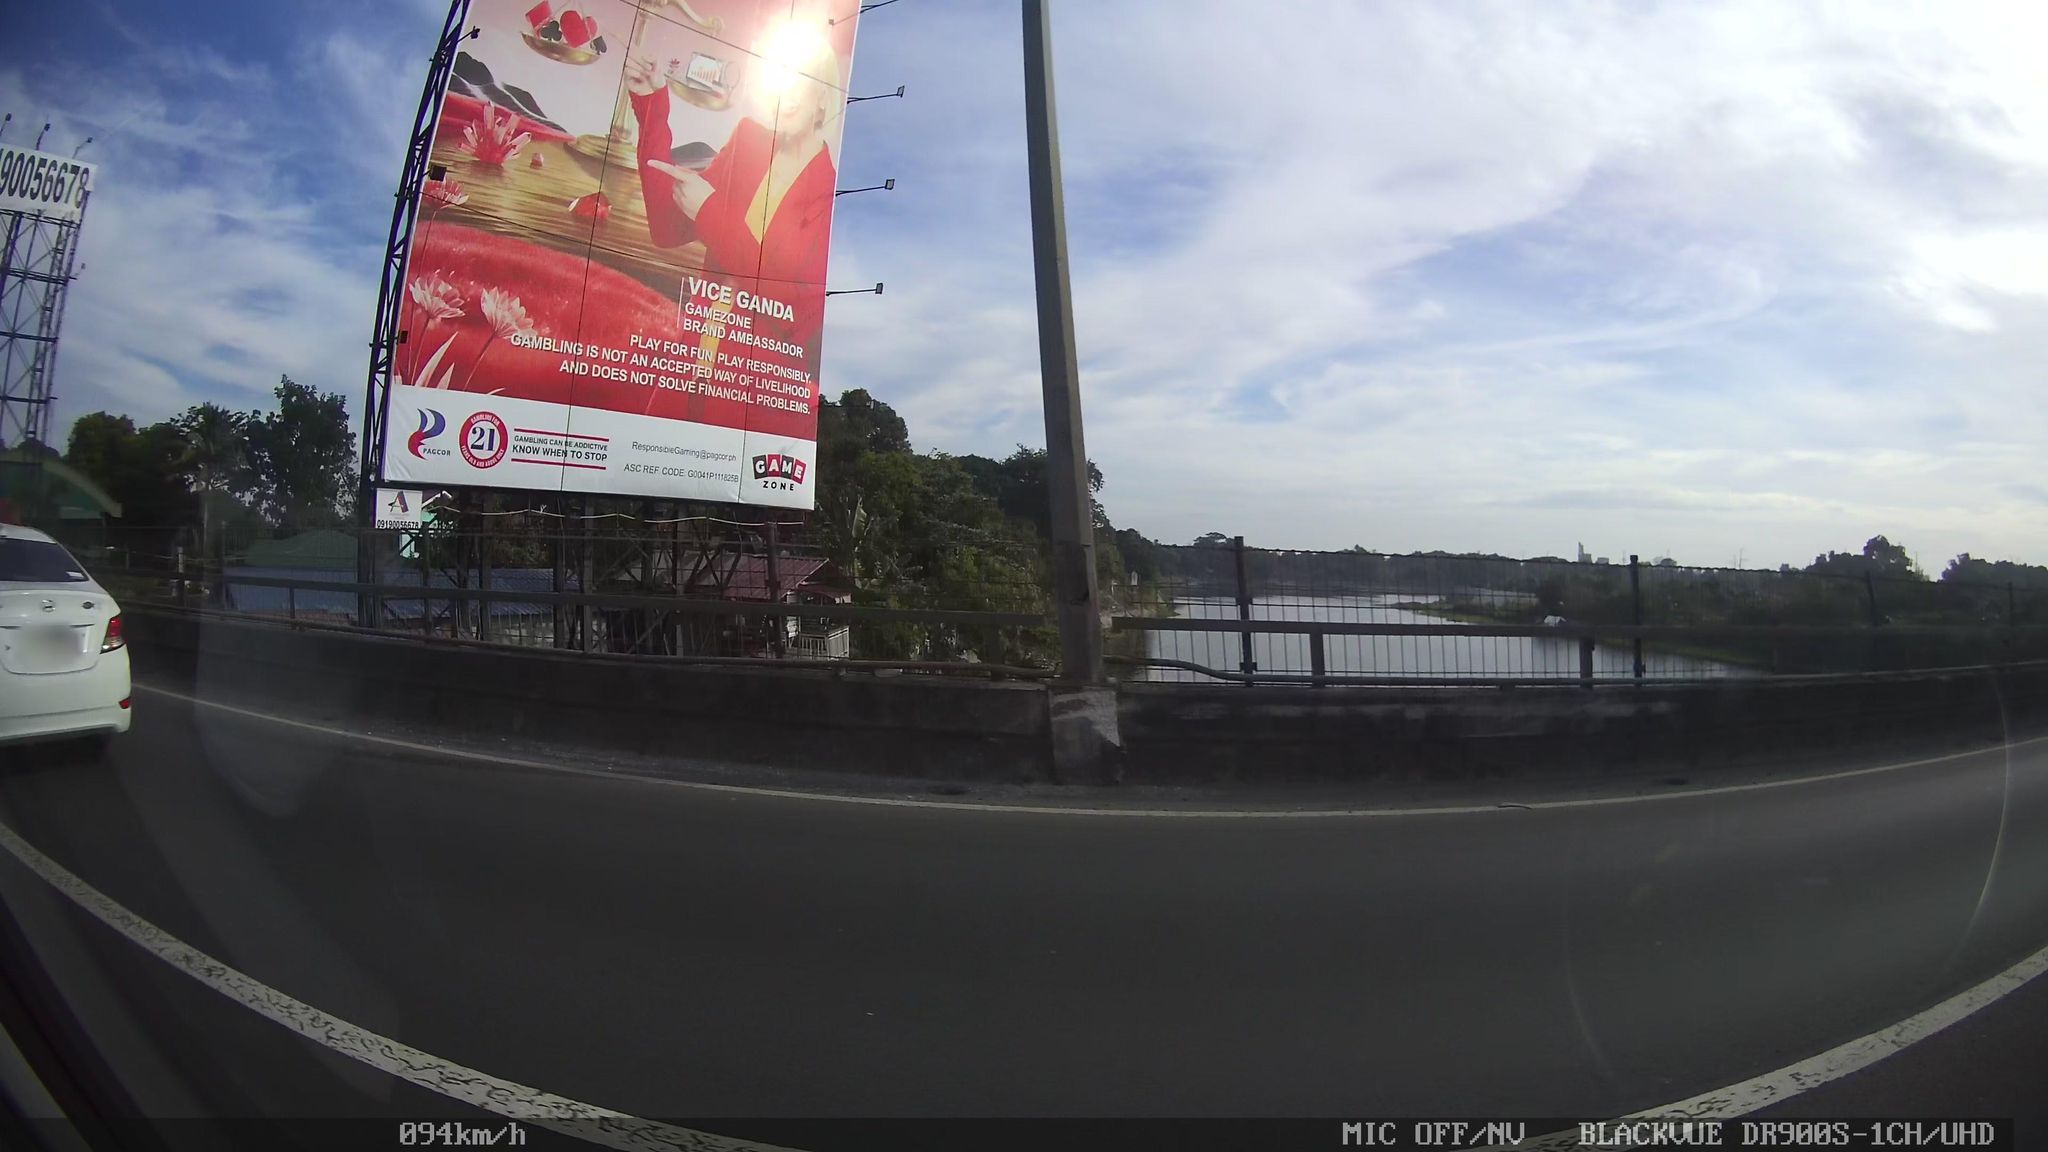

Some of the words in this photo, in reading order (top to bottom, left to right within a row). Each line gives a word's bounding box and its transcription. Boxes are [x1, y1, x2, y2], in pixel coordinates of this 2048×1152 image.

[0, 148, 91, 209] 90056678
[689, 276, 733, 305] VICE
[736, 291, 795, 323] GANDA
[684, 302, 752, 329] GAMEZONE
[683, 318, 726, 339] BRAND
[727, 330, 804, 359] AMBASSADOR
[511, 333, 584, 356] GAMBLING
[586, 344, 600, 359] IS
[601, 347, 629, 364] NOT
[629, 352, 649, 368] AN
[650, 357, 713, 380] ACCEPTED
[713, 368, 738, 386] WAY
[738, 374, 754, 388] OF
[755, 377, 811, 400] LIVELIHOOD
[630, 334, 662, 352] PLAY
[663, 341, 688, 357] FOR
[690, 346, 715, 363] FUN.
[717, 352, 746, 370] PLAY
[746, 359, 812, 384] RESPONSIBLY.
[559, 359, 590, 376] AND
[591, 364, 628, 383] DOES
[630, 371, 657, 387] NOT
[657, 375, 697, 394] SOLVE
[698, 382, 755, 405] FINANCIAL
[756, 394, 812, 415] PROBLEMS.
[422, 447, 451, 456] PAGCOR
[471, 426, 495, 451] 21
[514, 435, 548, 445] GAMBLING
[573, 442, 608, 451] ADDICTIVE
[512, 444, 540, 455] KNOW
[541, 447, 568, 458] WHEN
[570, 450, 583, 459] TO
[584, 452, 608, 462] STOP
[624, 463, 642, 473] ASC
[755, 458, 804, 480] GAME
[763, 480, 795, 491] ZONE
